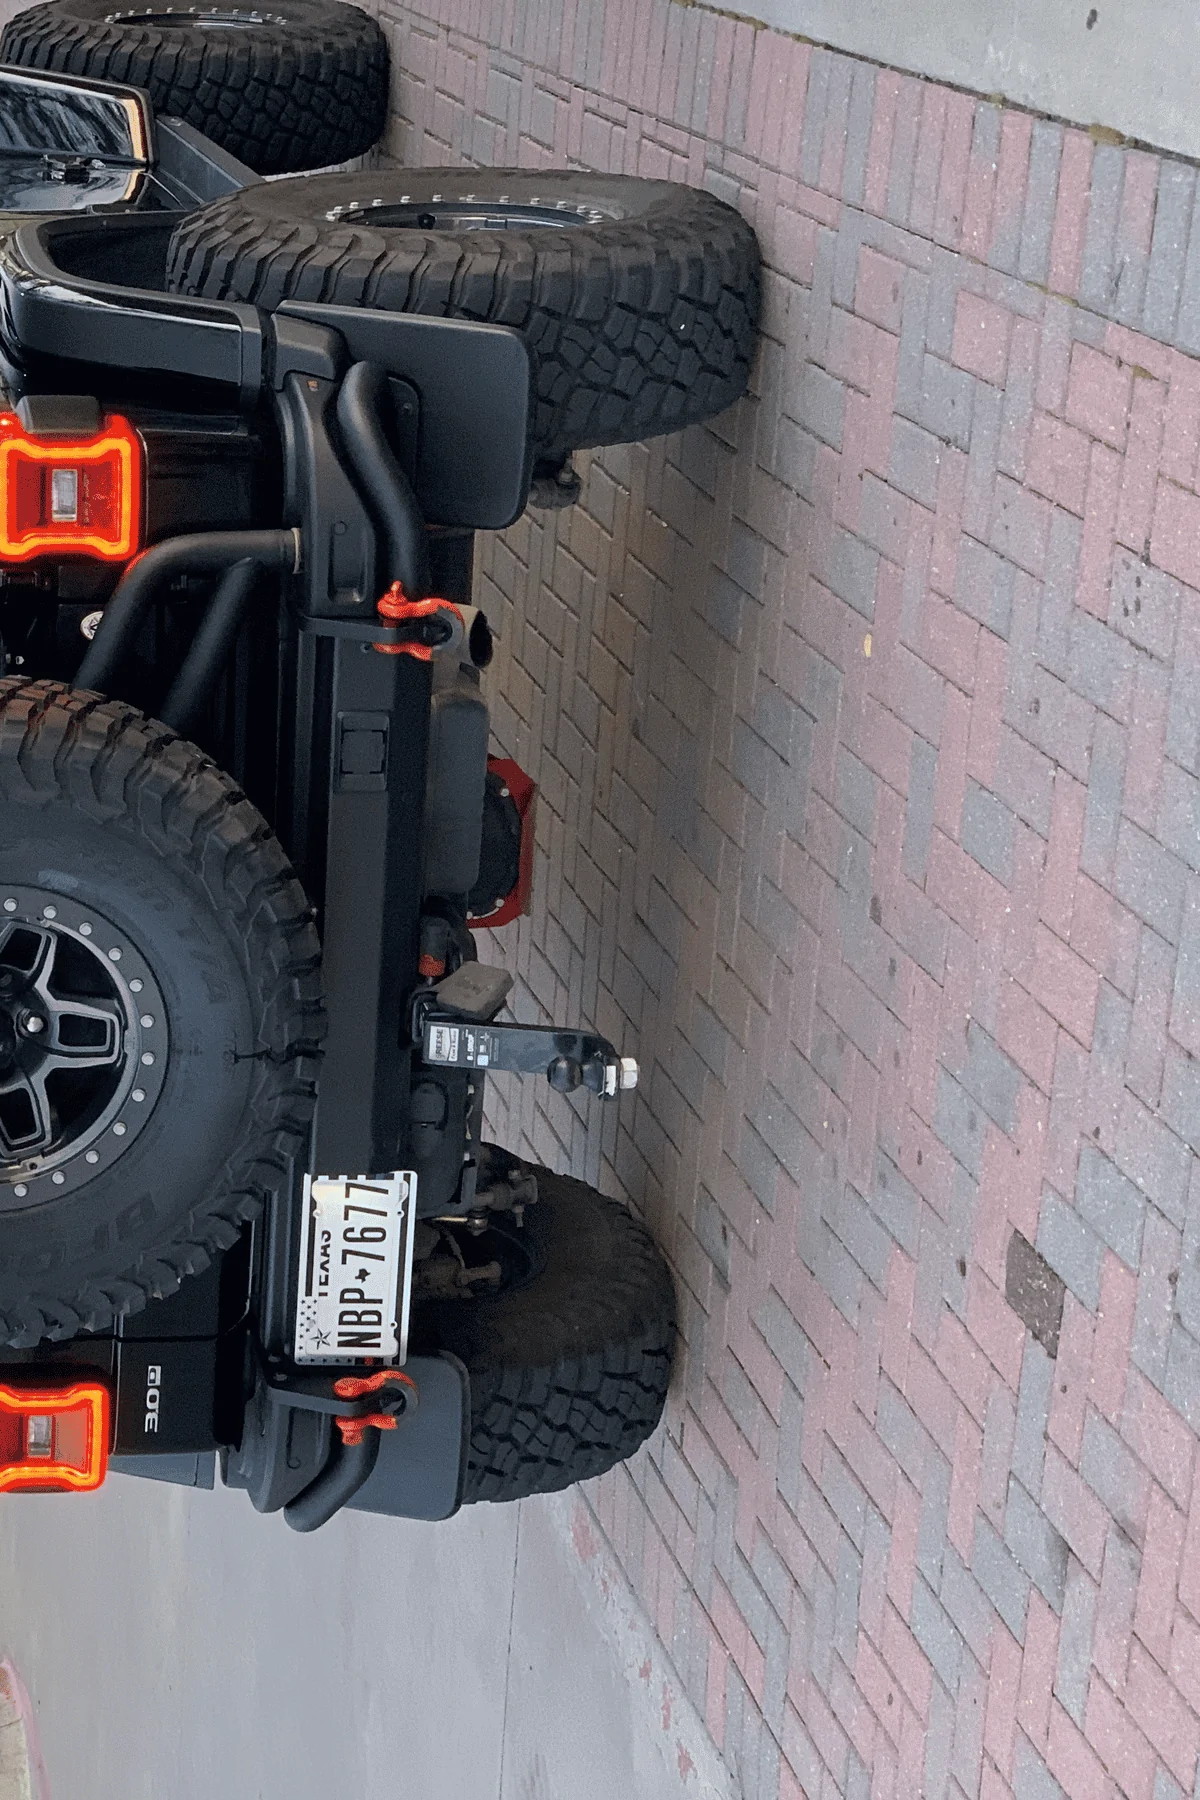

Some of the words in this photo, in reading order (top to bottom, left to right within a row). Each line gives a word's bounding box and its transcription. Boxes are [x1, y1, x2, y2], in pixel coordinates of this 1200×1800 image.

[435, 1028, 443, 1055] REESE
[341, 1182, 389, 1265] 7677
[318, 1230, 331, 1297] TEXAS
[337, 1288, 383, 1348] NBP
